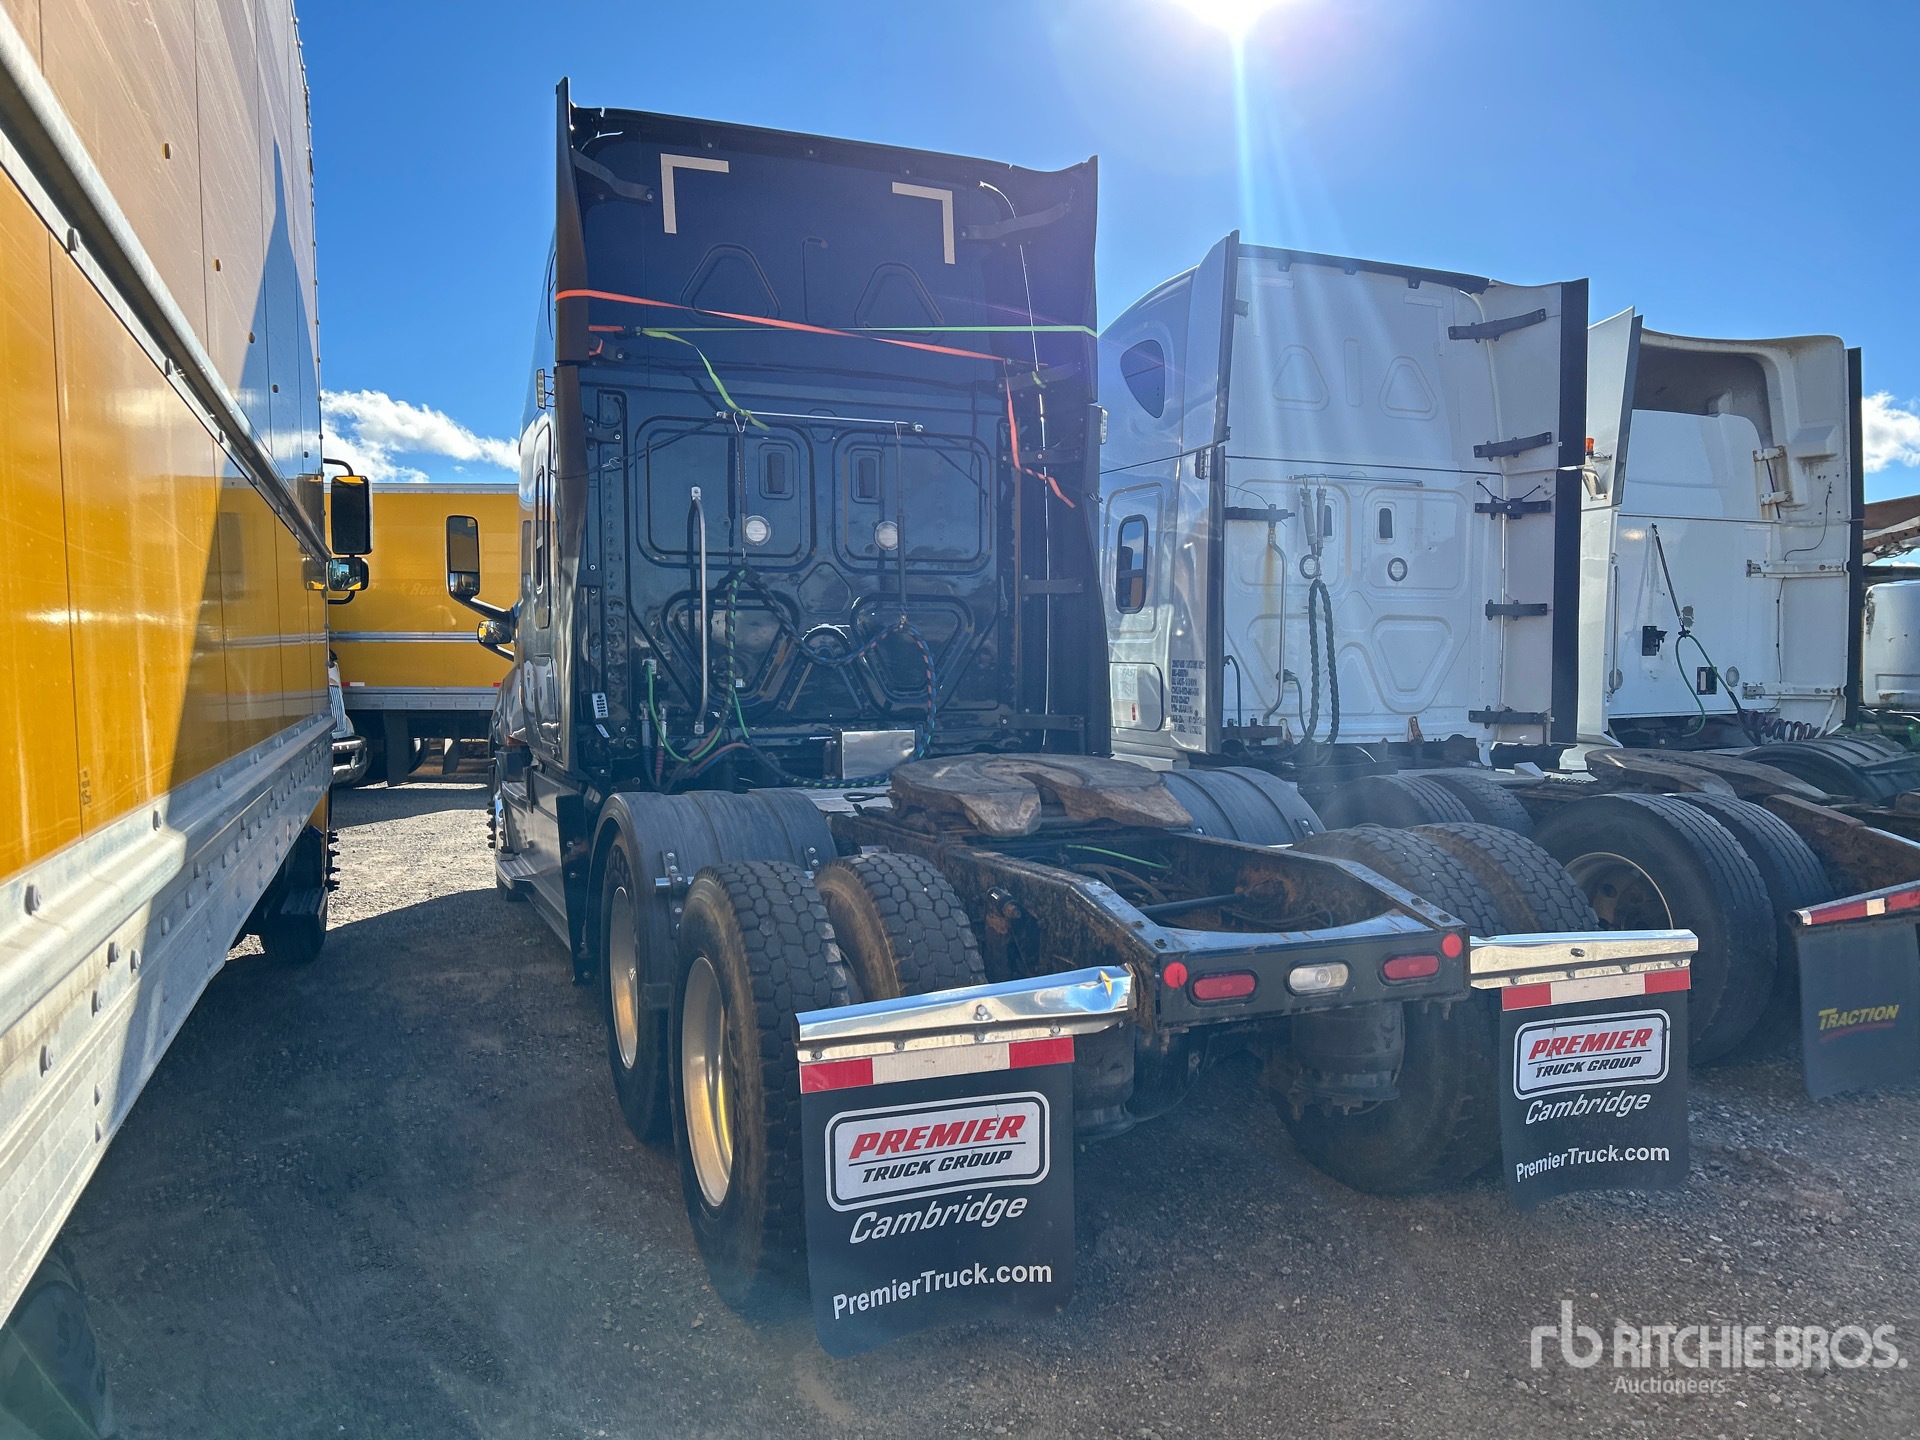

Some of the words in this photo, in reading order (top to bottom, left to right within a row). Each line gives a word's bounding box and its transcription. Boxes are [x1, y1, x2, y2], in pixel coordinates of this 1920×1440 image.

[1819, 1004, 1900, 1031] TRACTION
[1528, 1028, 1653, 1060] PREMIER
[1536, 1061, 1584, 1078] TRUCK
[1587, 1056, 1642, 1072] GROUP
[1525, 1090, 1651, 1125] Cambridge
[848, 1115, 1027, 1160] PREMIER
[862, 1160, 937, 1183] TRUCK
[938, 1150, 1013, 1171] GROUP
[1516, 1145, 1670, 1183] PremierTruck.com
[850, 1193, 1028, 1245] Cambridge
[833, 1262, 1052, 1320] PremierTruck.com
